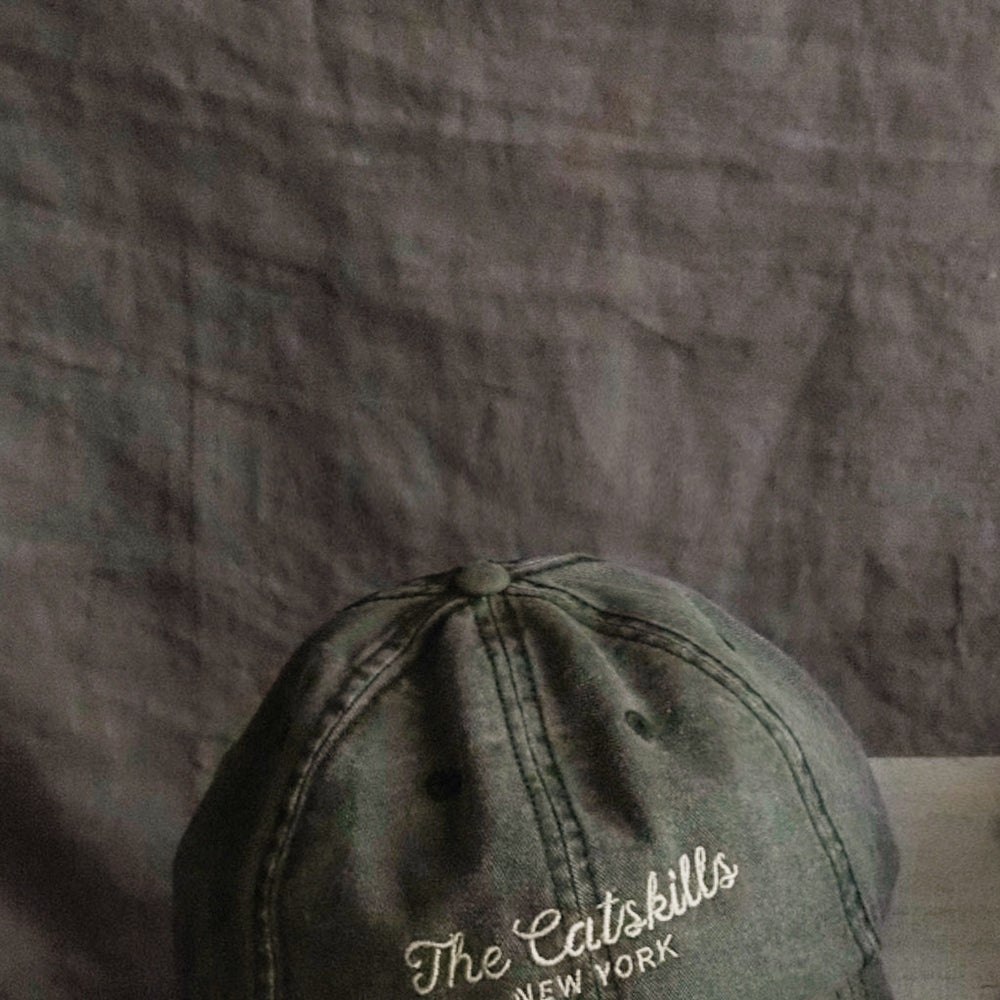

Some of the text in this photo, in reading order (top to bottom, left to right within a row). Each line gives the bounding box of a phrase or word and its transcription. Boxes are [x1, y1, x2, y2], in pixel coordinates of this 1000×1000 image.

[404, 846, 739, 995] The Catskills
[594, 934, 679, 986] YORK
